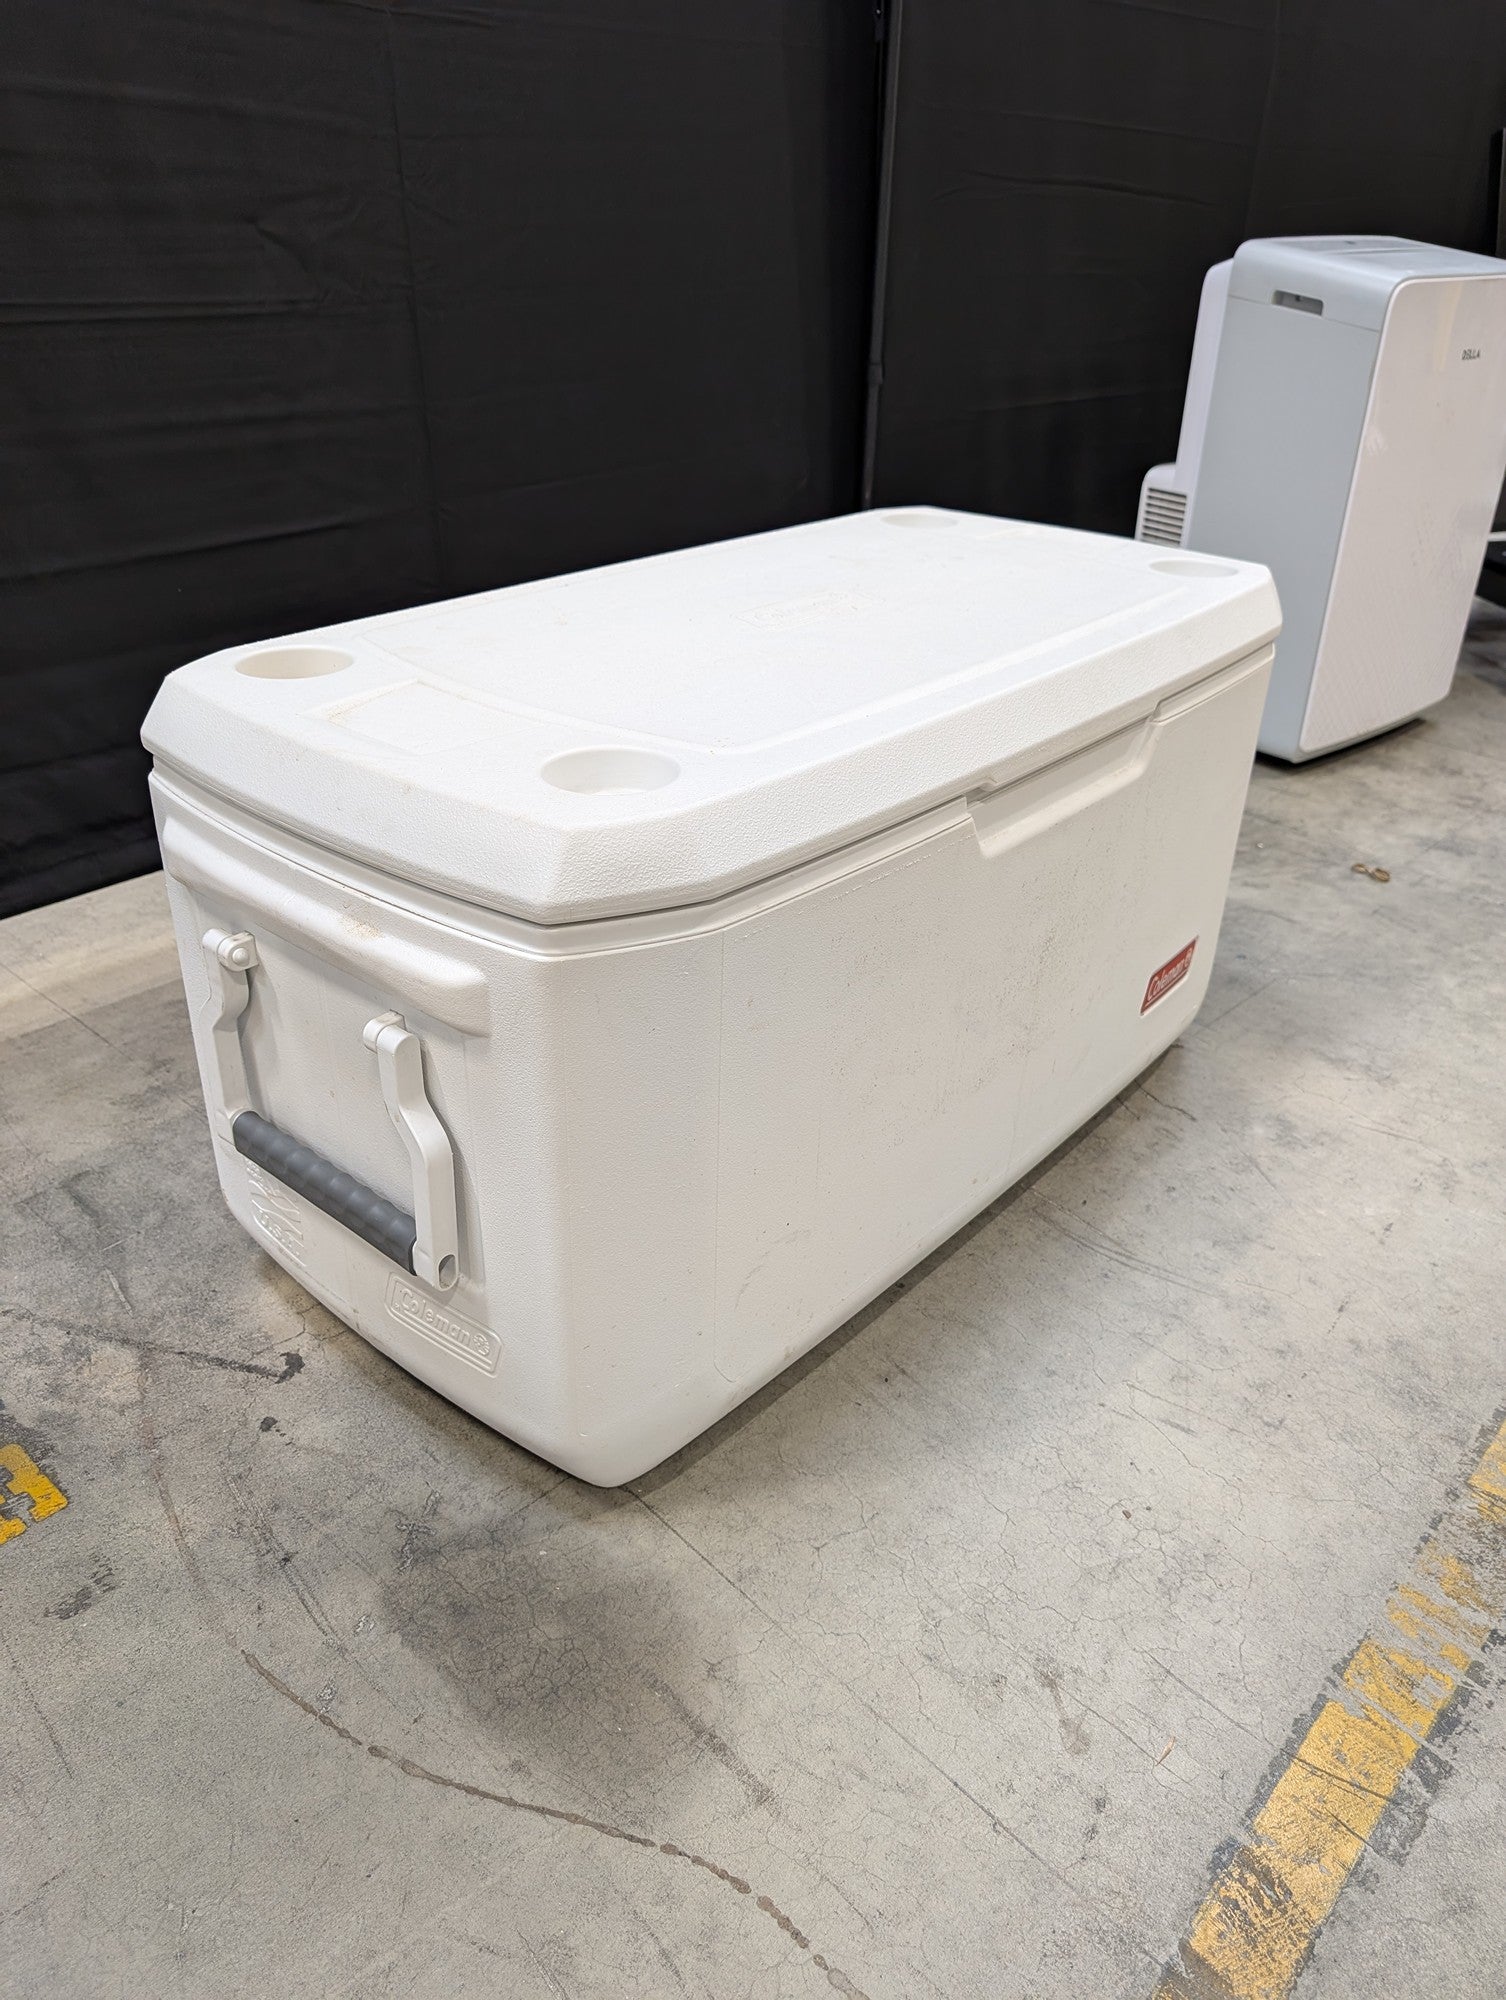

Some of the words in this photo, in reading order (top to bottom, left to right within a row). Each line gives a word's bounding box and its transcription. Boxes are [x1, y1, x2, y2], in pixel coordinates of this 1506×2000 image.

[1461, 348, 1480, 361] DELLA
[1147, 957, 1185, 1001] Coleman
[401, 1287, 472, 1346] Coleman
